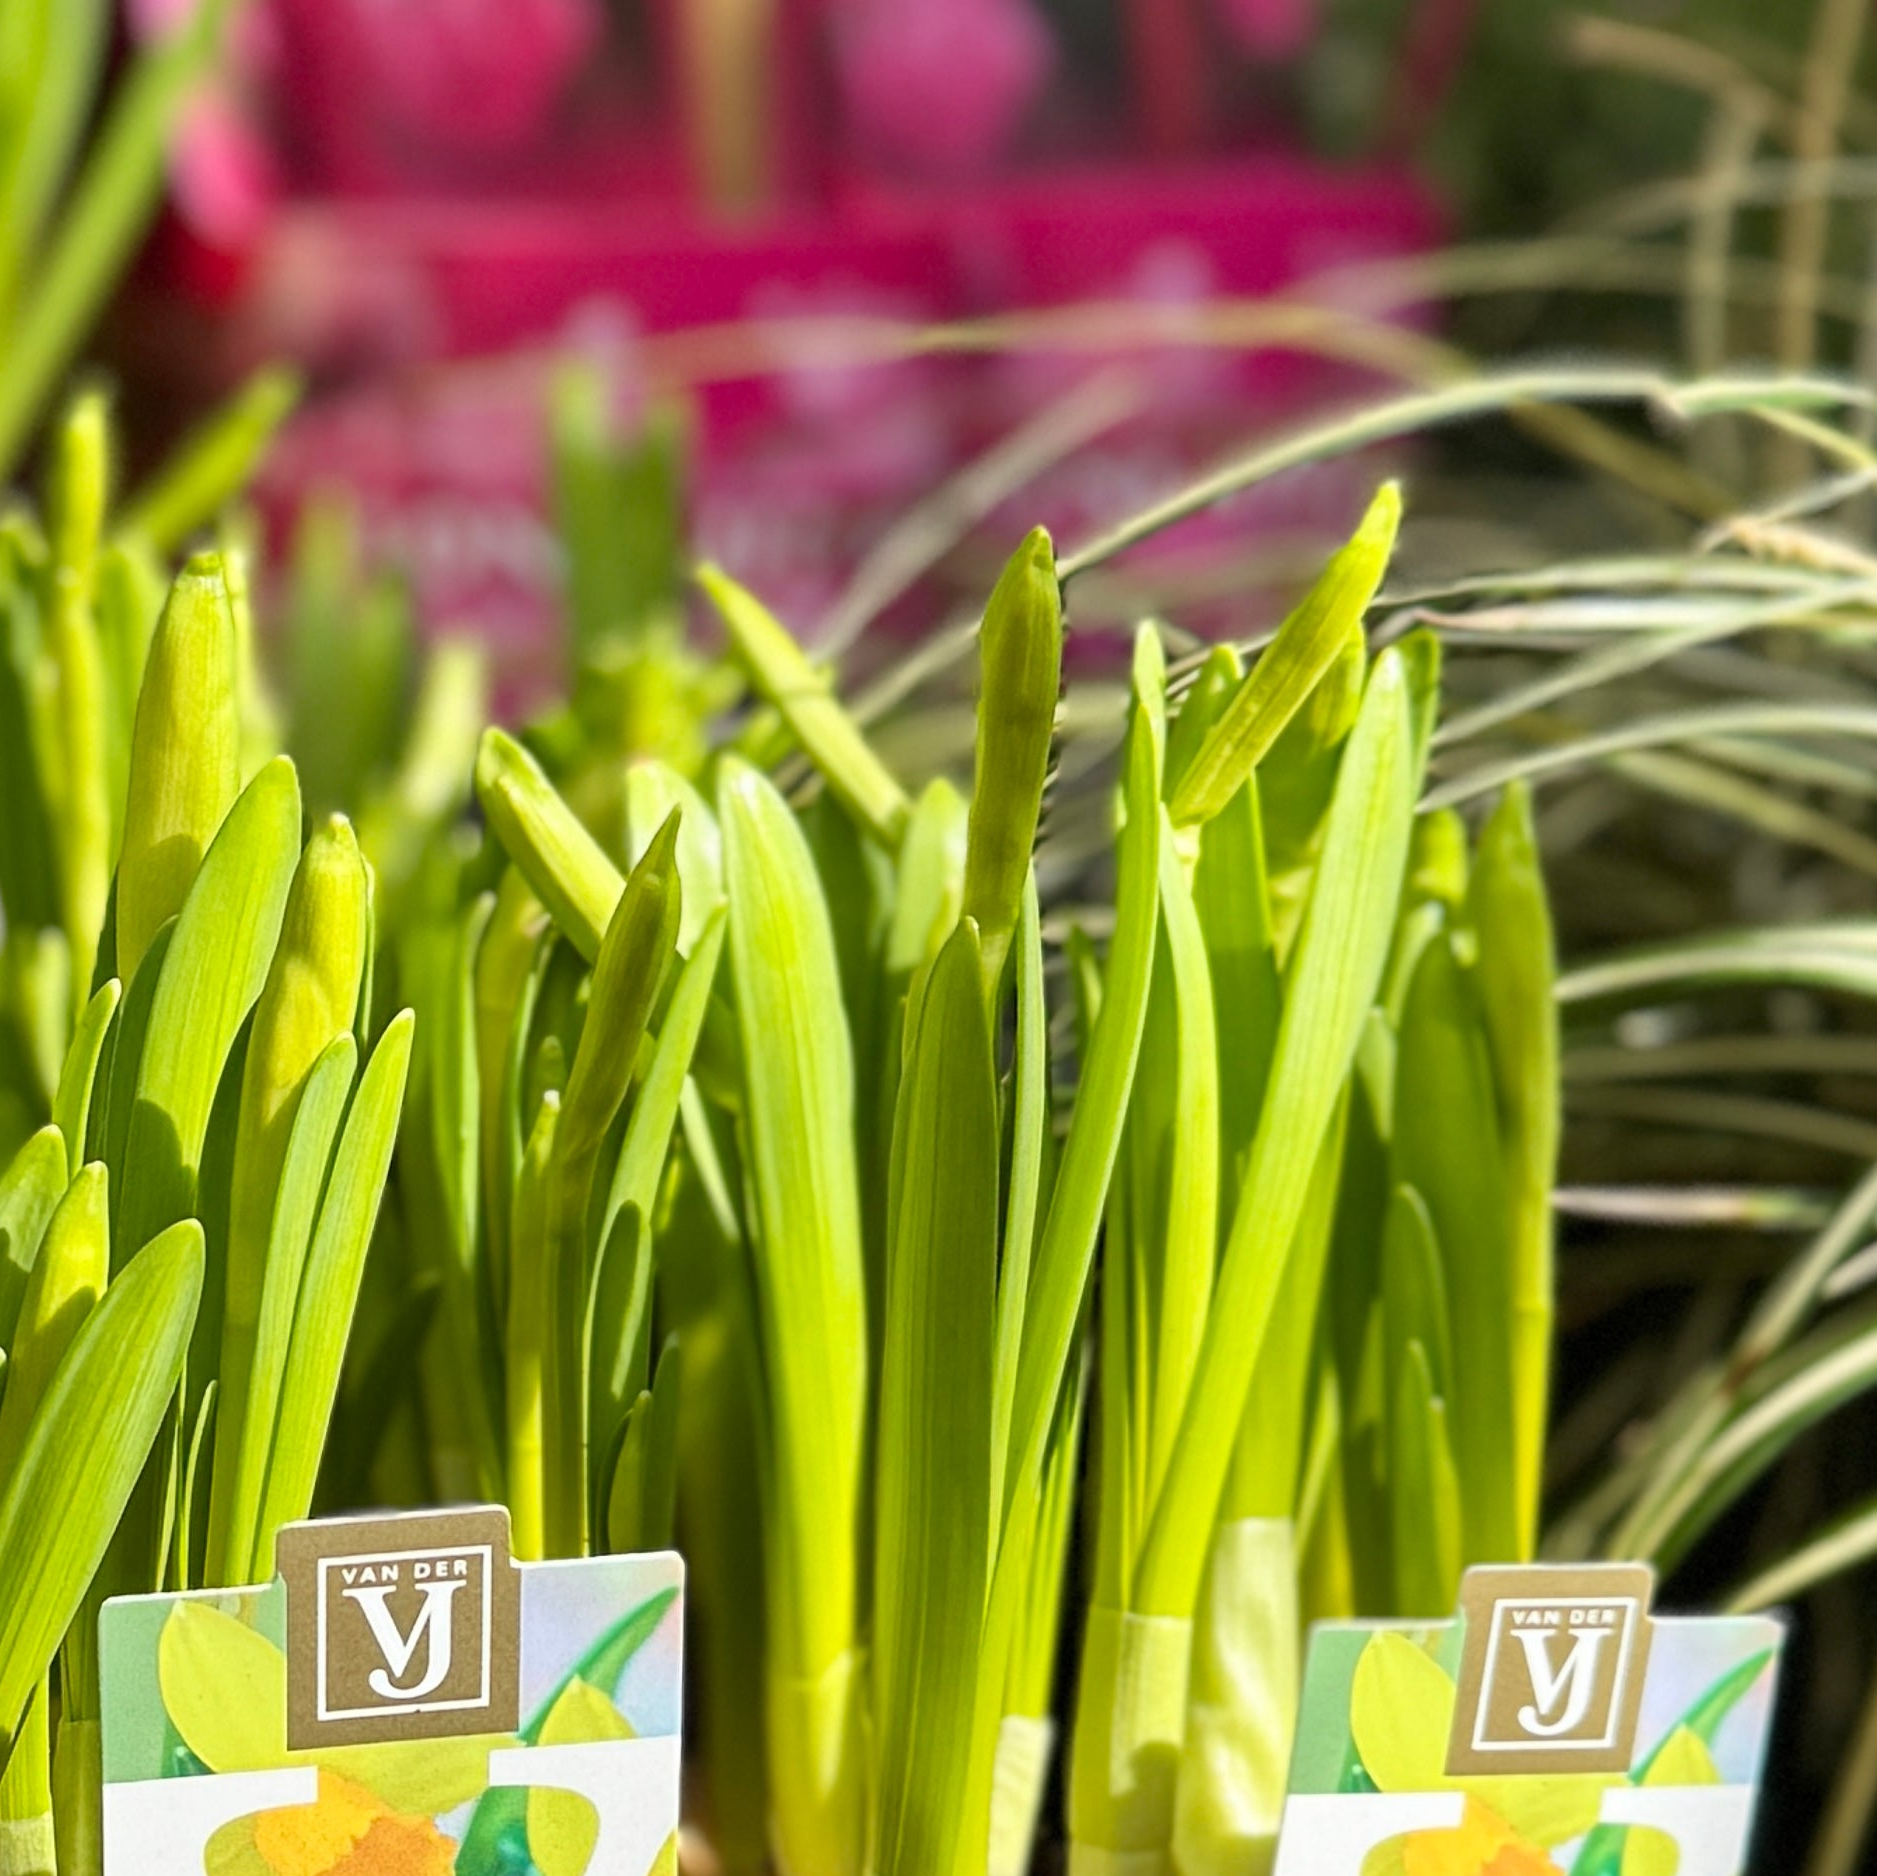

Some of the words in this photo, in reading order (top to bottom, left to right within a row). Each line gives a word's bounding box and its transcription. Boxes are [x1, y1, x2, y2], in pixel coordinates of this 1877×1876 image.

[341, 1564, 399, 1585] VAN
[413, 1559, 468, 1580] DER
[1511, 1609, 1560, 1625] VAN
[1568, 1609, 1616, 1625] DER
